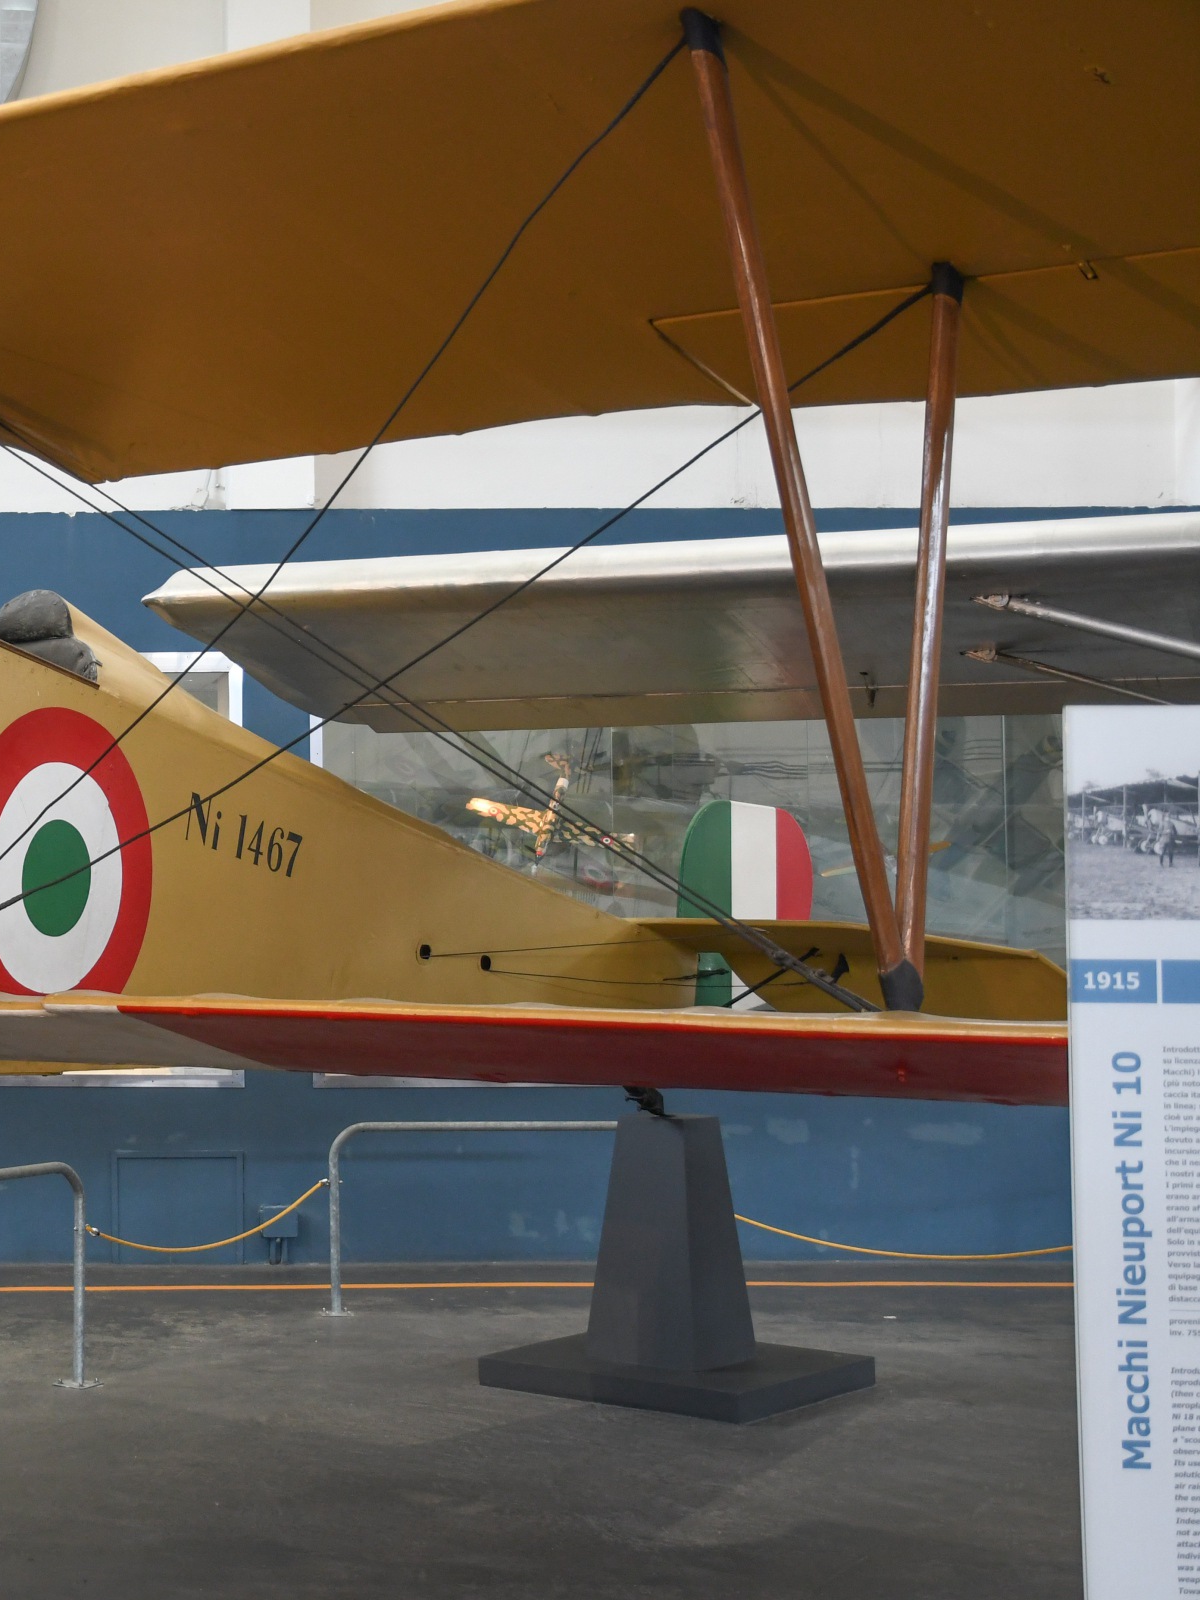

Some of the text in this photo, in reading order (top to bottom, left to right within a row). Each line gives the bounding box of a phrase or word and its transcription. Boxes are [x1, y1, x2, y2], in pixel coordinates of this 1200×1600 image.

[185, 791, 303, 878] Ni 1467
[1083, 971, 1140, 990] 1915
[1111, 1051, 1153, 1470] Macchi Nieuport Ni 10
